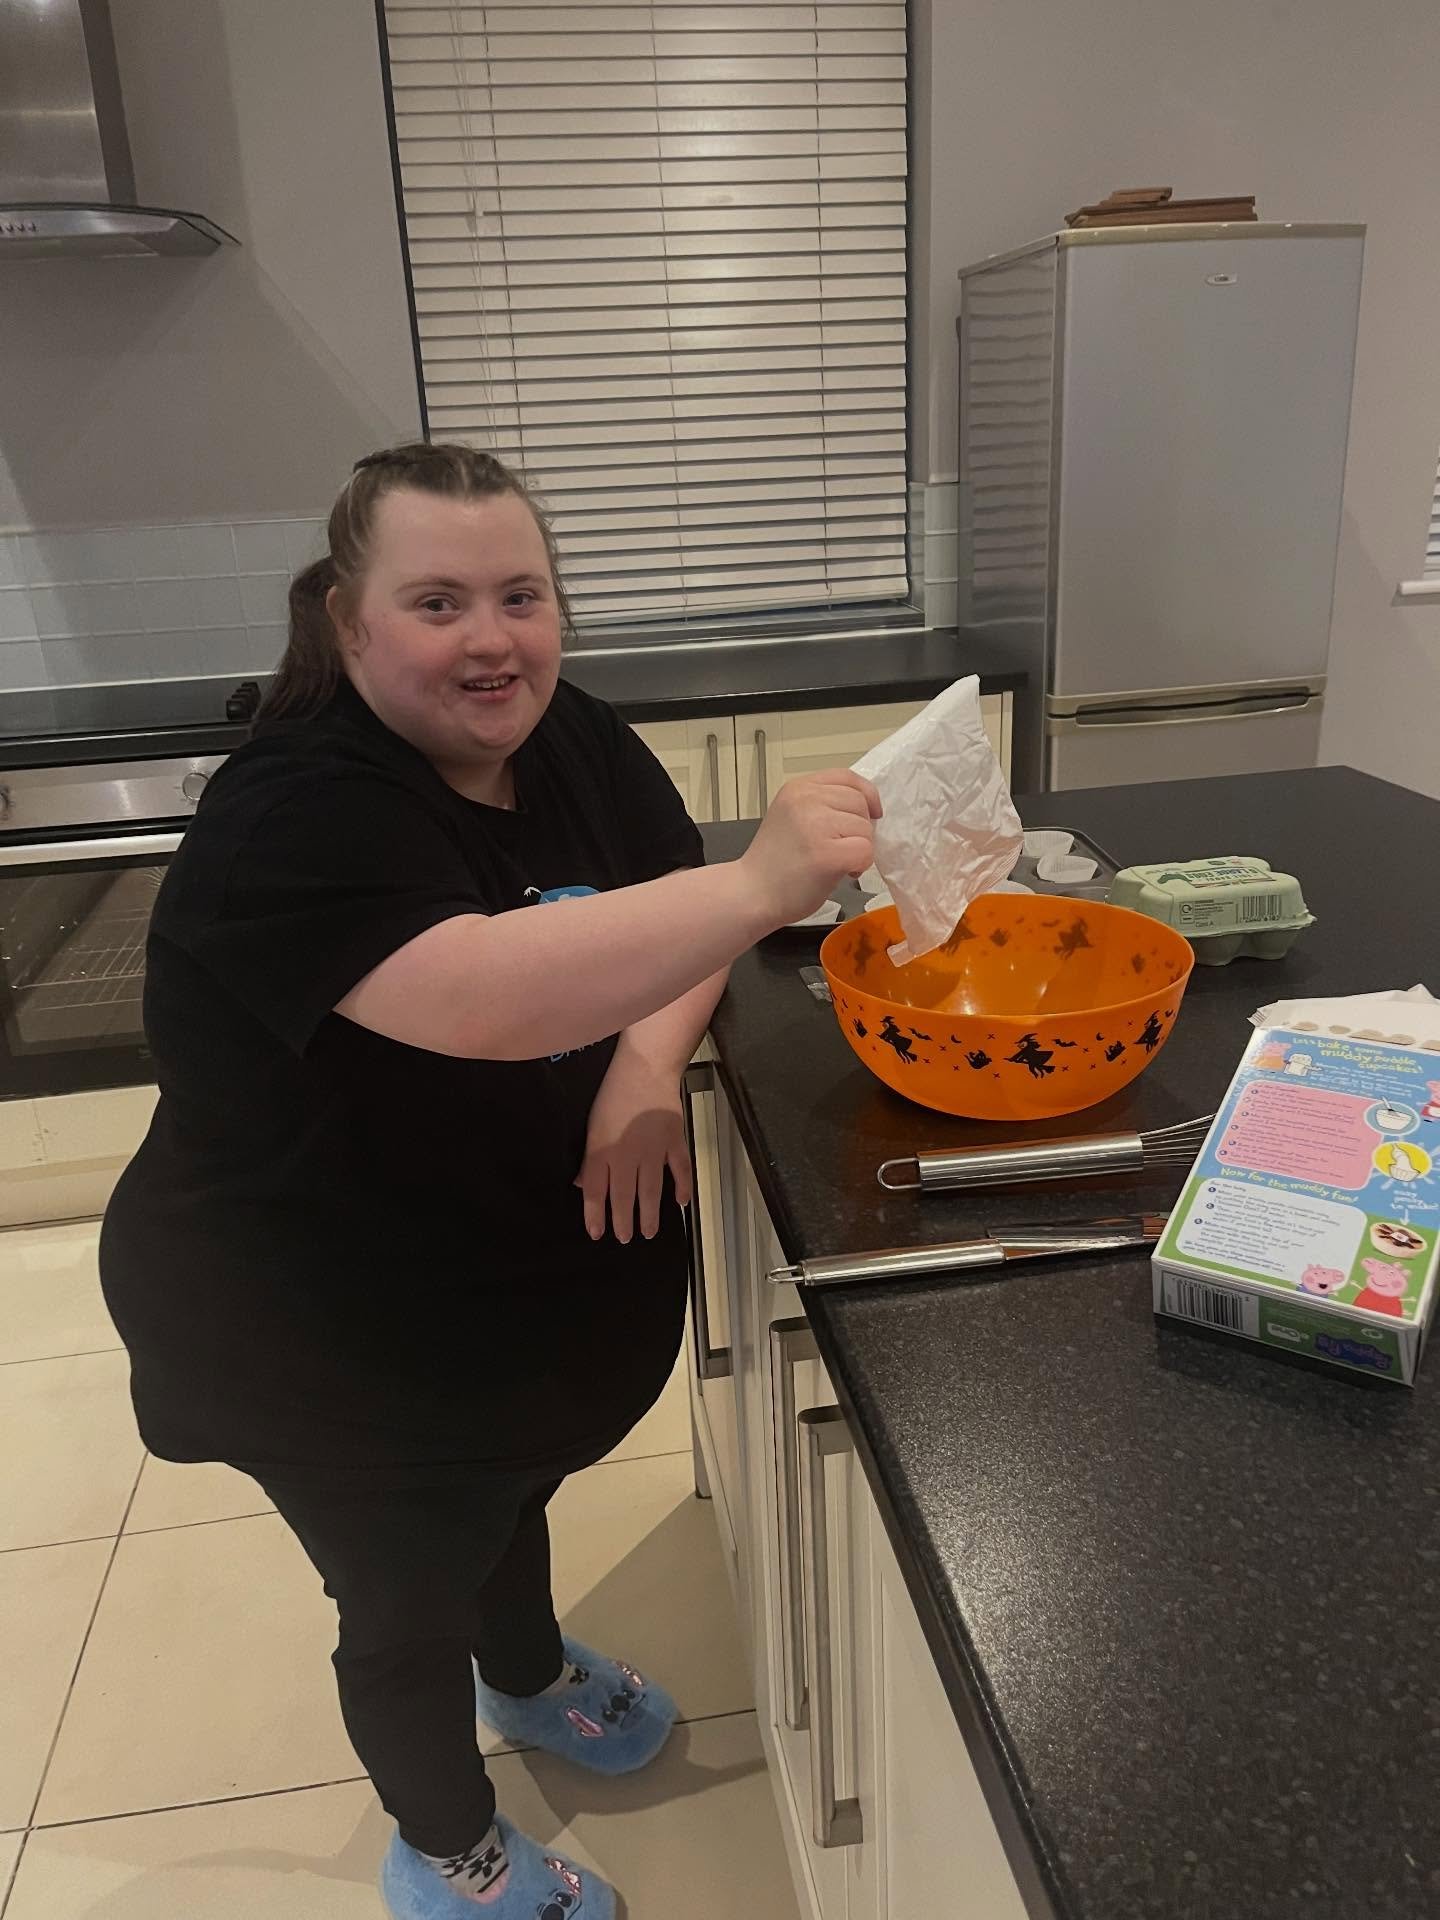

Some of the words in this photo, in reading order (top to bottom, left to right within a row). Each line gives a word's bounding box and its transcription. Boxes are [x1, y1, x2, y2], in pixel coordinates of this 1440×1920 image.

[1318, 1040, 1350, 1051] bake
[1321, 1050, 1372, 1063] muddy
[1220, 1167, 1246, 1177] Now
[1247, 1171, 1265, 1182] for
[1267, 1178, 1288, 1190] the
[1290, 1183, 1330, 1197] muddy
